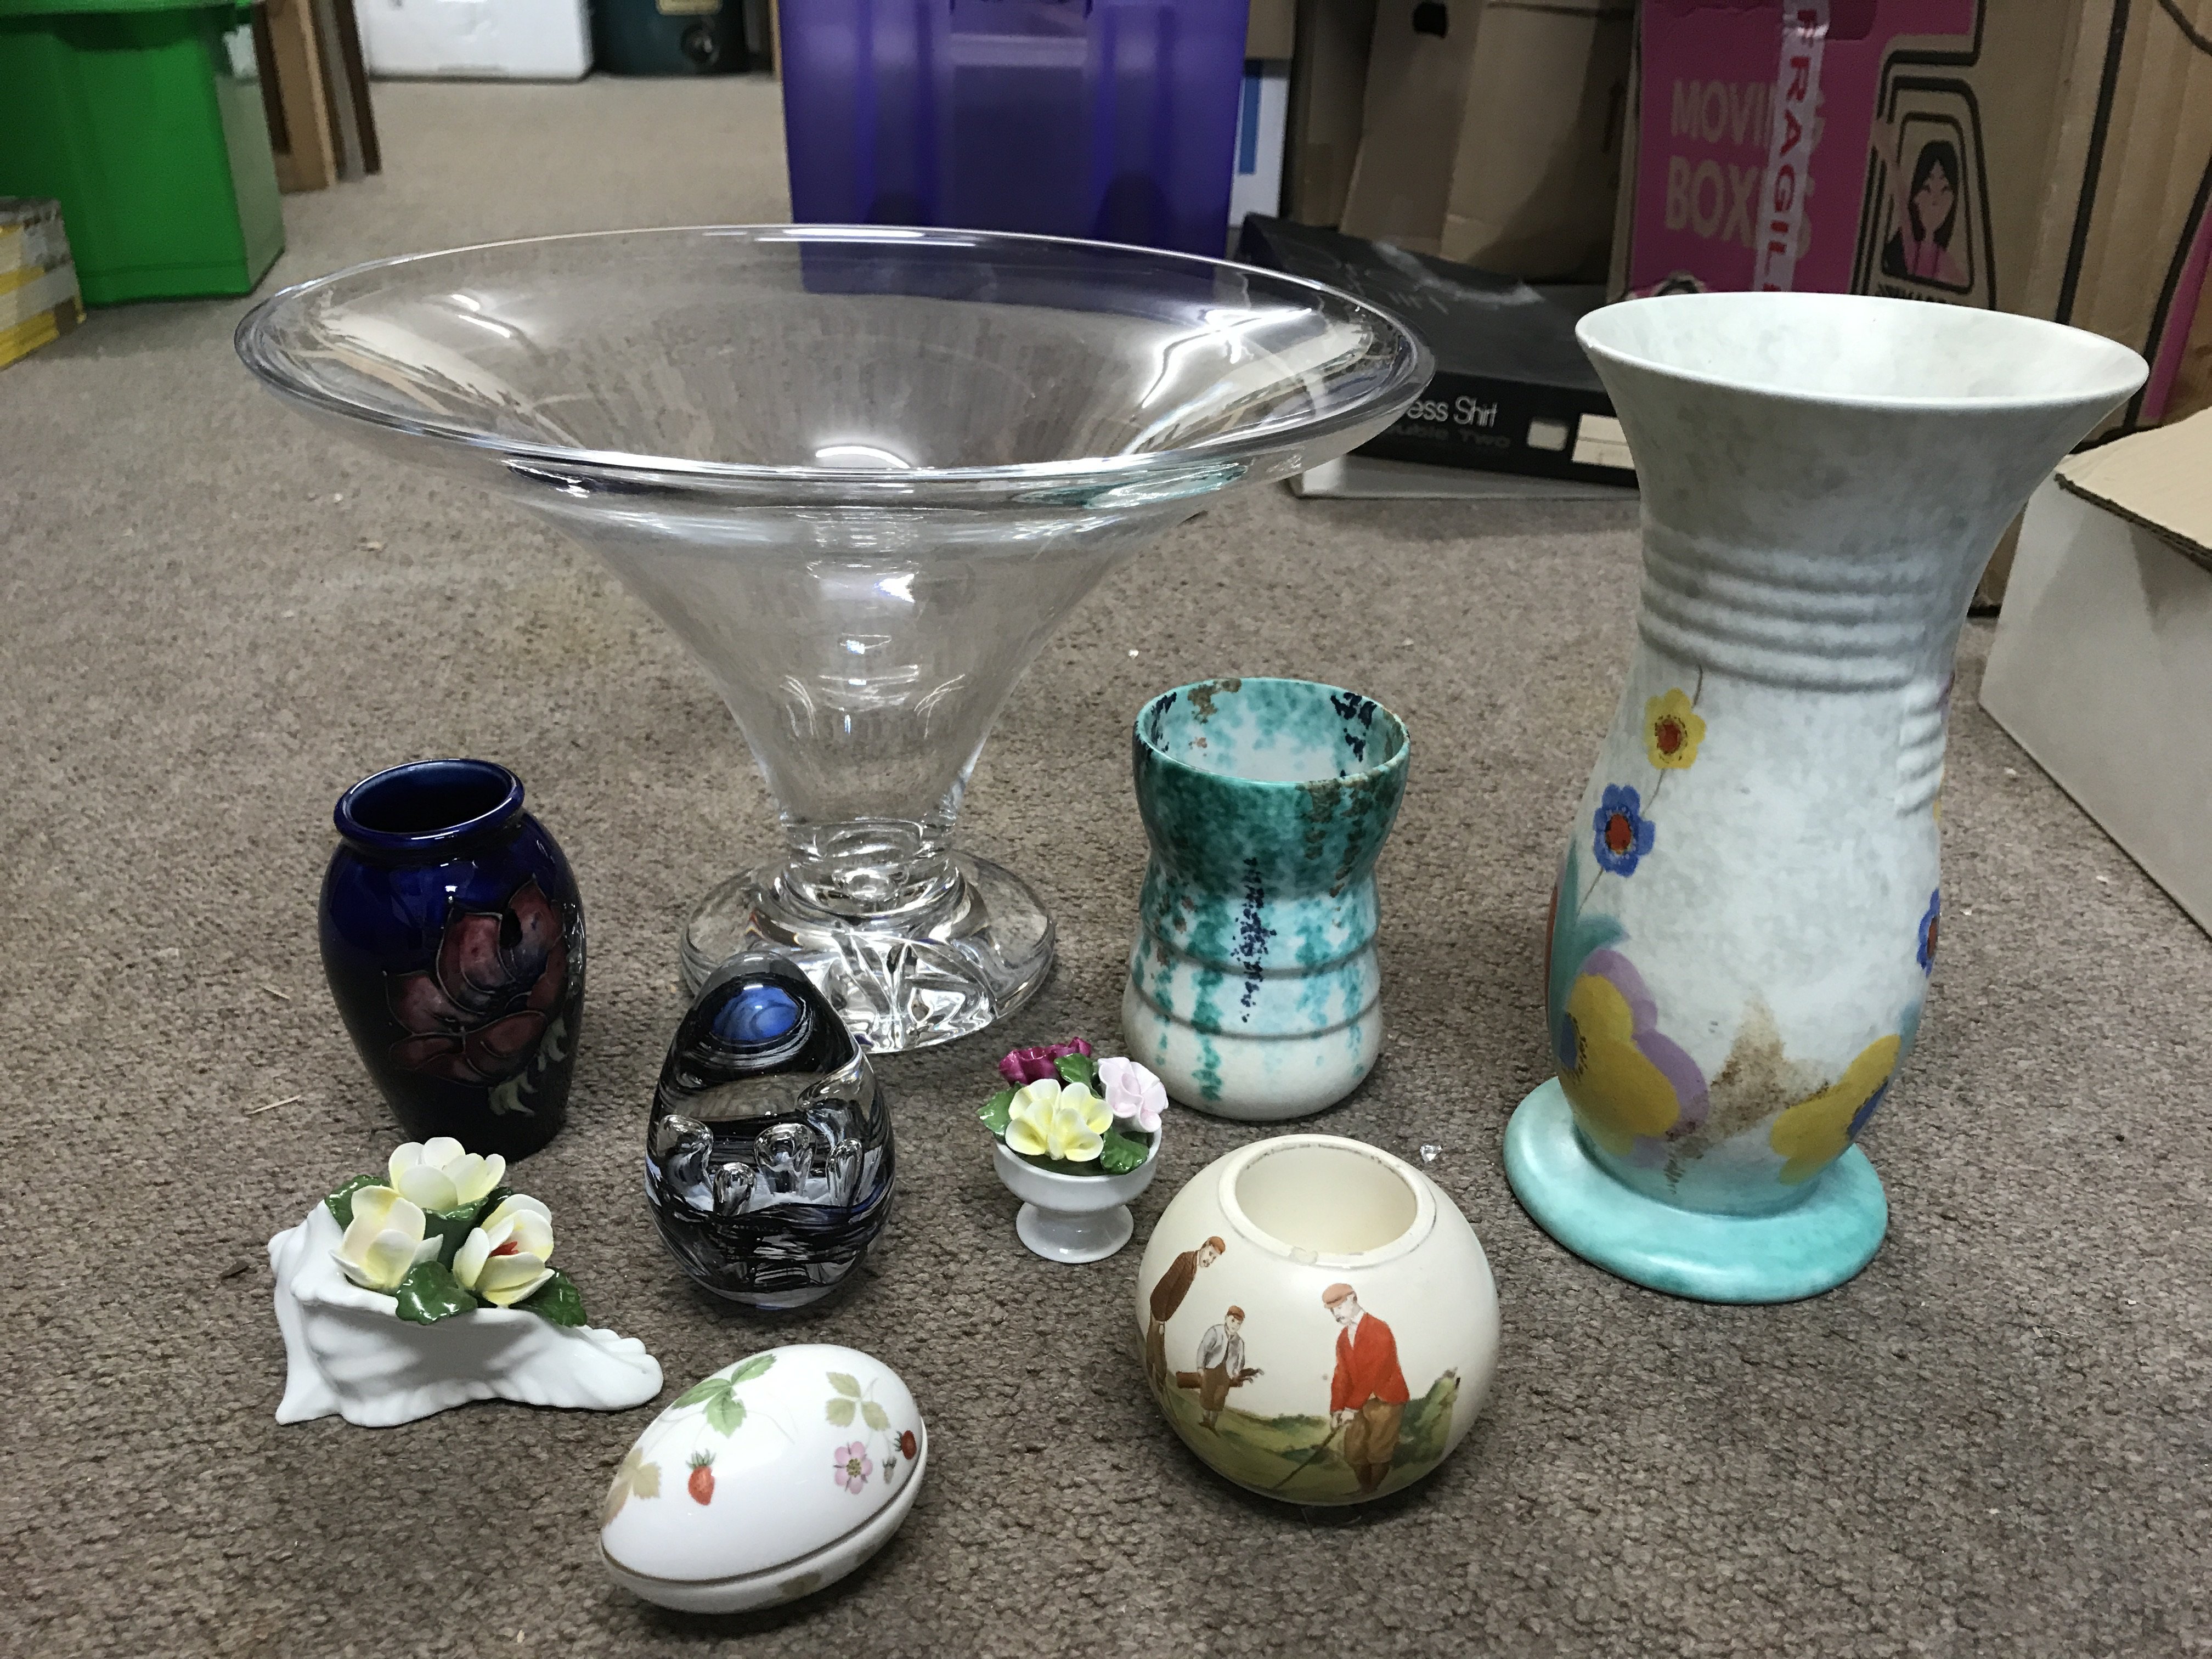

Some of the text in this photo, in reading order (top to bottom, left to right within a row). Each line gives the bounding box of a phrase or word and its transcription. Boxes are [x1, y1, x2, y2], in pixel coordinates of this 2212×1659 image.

[1672, 80, 1825, 152] MOVI
[1763, 9, 1818, 292] FRAGIL
[1665, 156, 1815, 259] BOX
[1406, 395, 1498, 427] ess Shirt
